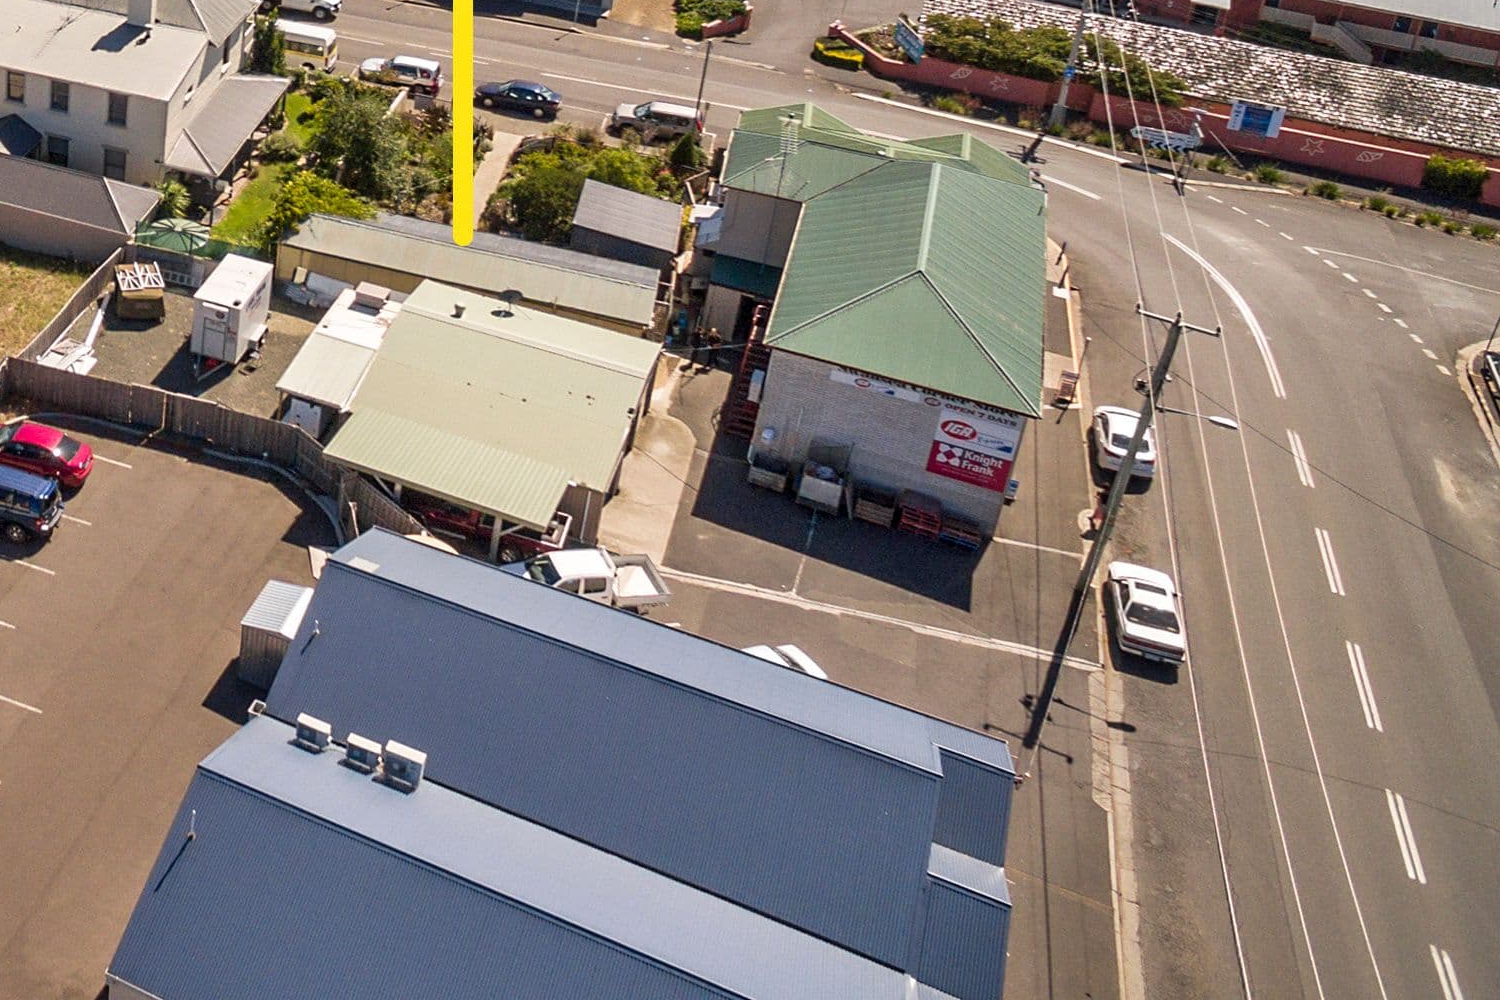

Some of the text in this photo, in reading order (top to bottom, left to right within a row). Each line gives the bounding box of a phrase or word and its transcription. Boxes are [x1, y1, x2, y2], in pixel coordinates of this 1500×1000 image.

[944, 403, 1017, 427] OPEN 7 DAYS
[944, 422, 974, 439] IGA
[961, 460, 995, 477] Frank
[963, 451, 1003, 470] Knight
